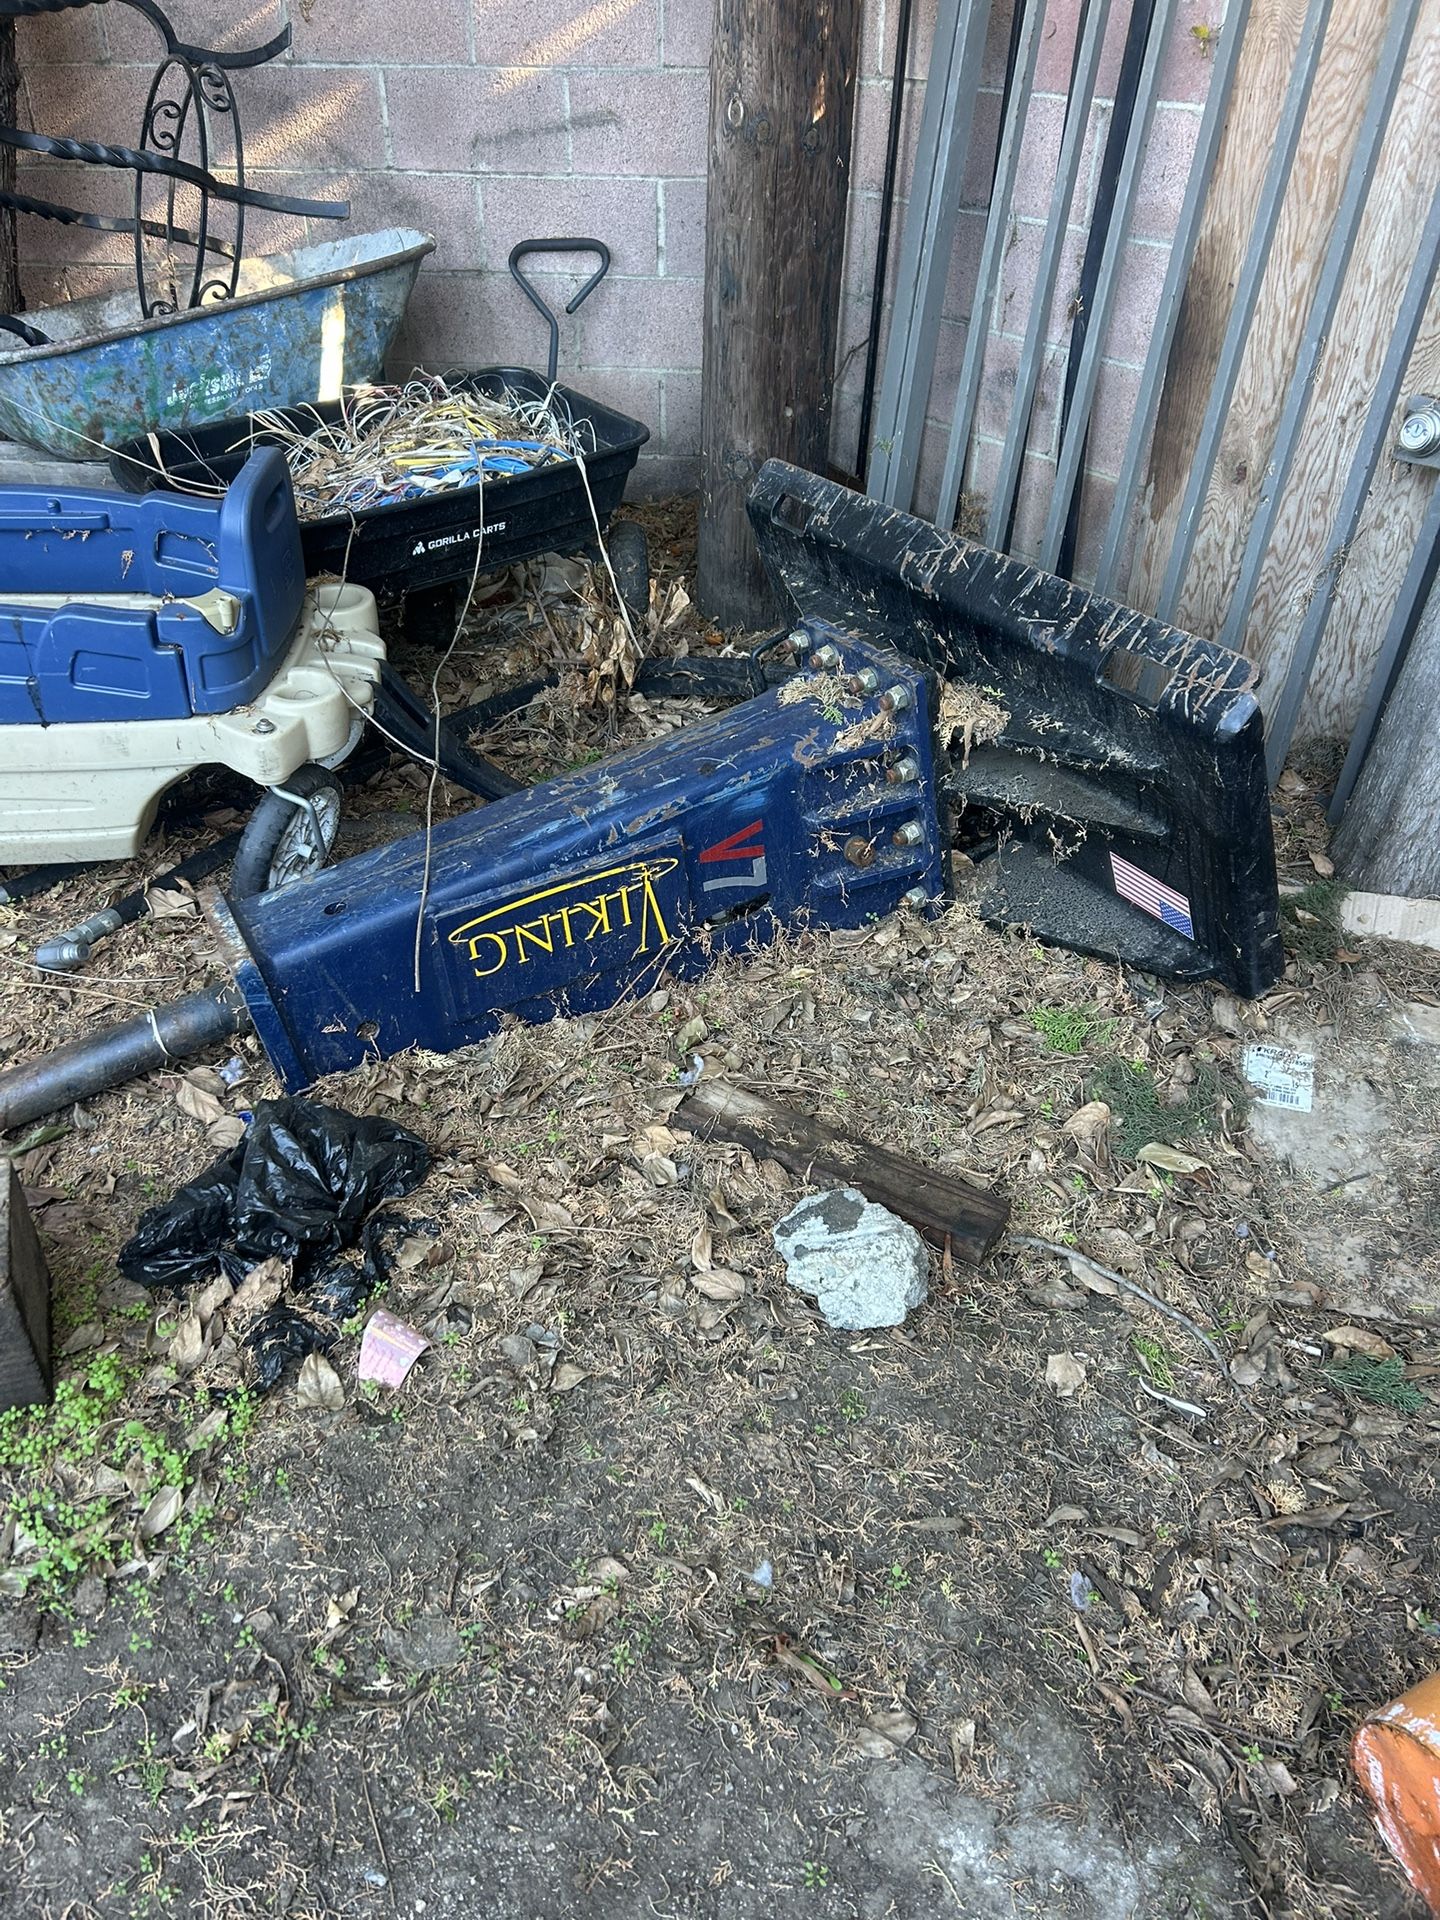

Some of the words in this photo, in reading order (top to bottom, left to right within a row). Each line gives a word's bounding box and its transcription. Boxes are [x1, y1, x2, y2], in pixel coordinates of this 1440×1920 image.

[428, 532, 470, 550] GORILLA
[472, 521, 507, 538] CARTS
[467, 865, 672, 977] VIKING
